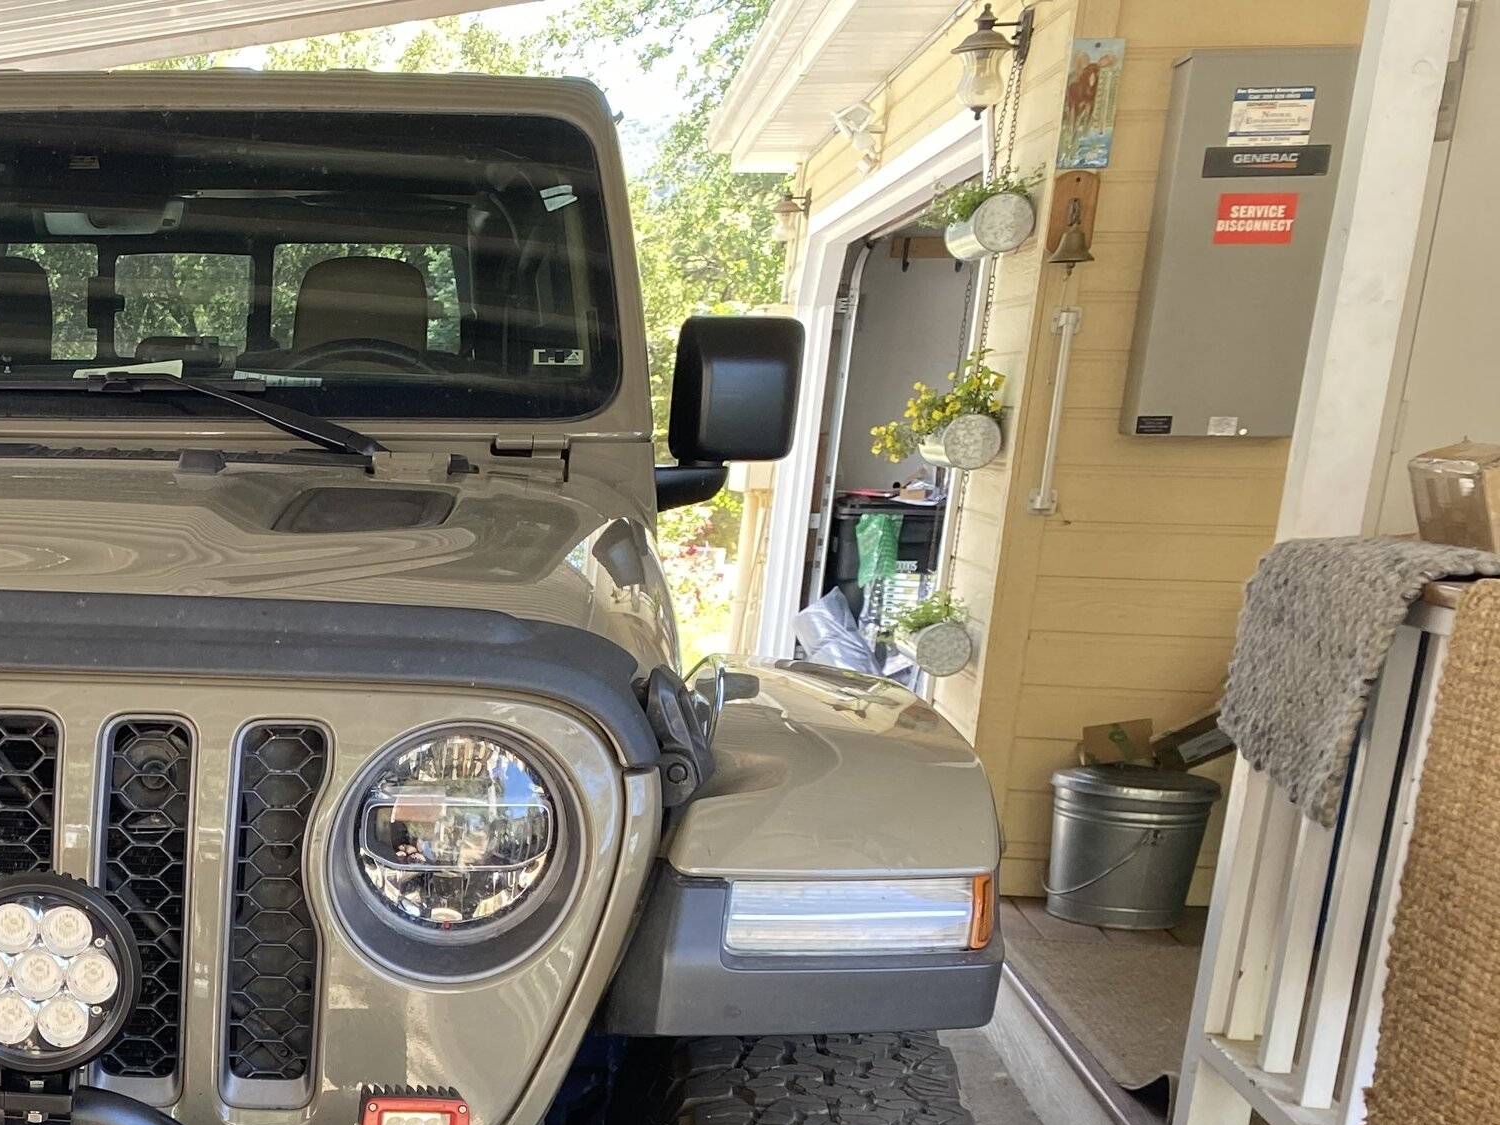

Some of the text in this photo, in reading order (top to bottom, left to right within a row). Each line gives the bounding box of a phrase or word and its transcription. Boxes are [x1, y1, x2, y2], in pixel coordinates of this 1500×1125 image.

[1233, 153, 1299, 164] GENERAC
[1230, 205, 1286, 218] SERVICE
[1216, 219, 1294, 232] DISCONNECT
